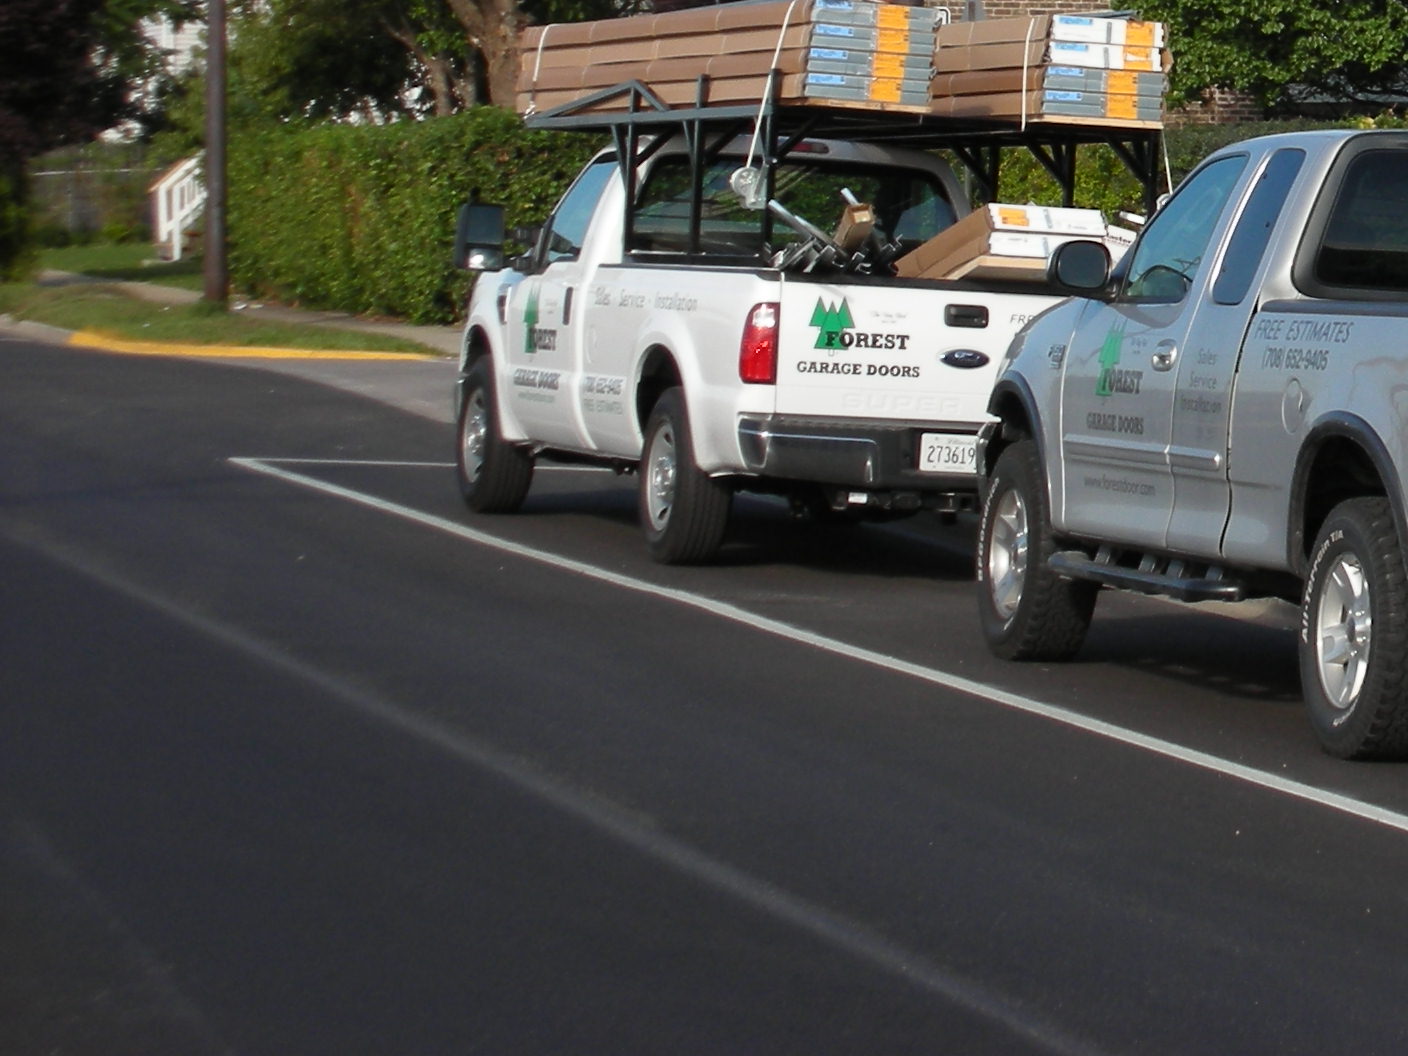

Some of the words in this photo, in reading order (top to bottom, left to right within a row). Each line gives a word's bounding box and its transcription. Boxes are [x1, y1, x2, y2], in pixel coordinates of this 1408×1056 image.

[619, 288, 645, 308] Service
[826, 330, 910, 350] FOREST
[1255, 319, 1285, 340] FREE
[1285, 320, 1354, 344] ESTIMATES
[797, 361, 862, 376] GARAGE
[866, 364, 920, 378] DOORS
[1284, 348, 1330, 371] 652-9405
[842, 393, 962, 416] SUPER
[1086, 412, 1116, 433] GARAGE
[1118, 414, 1144, 435] DOORS
